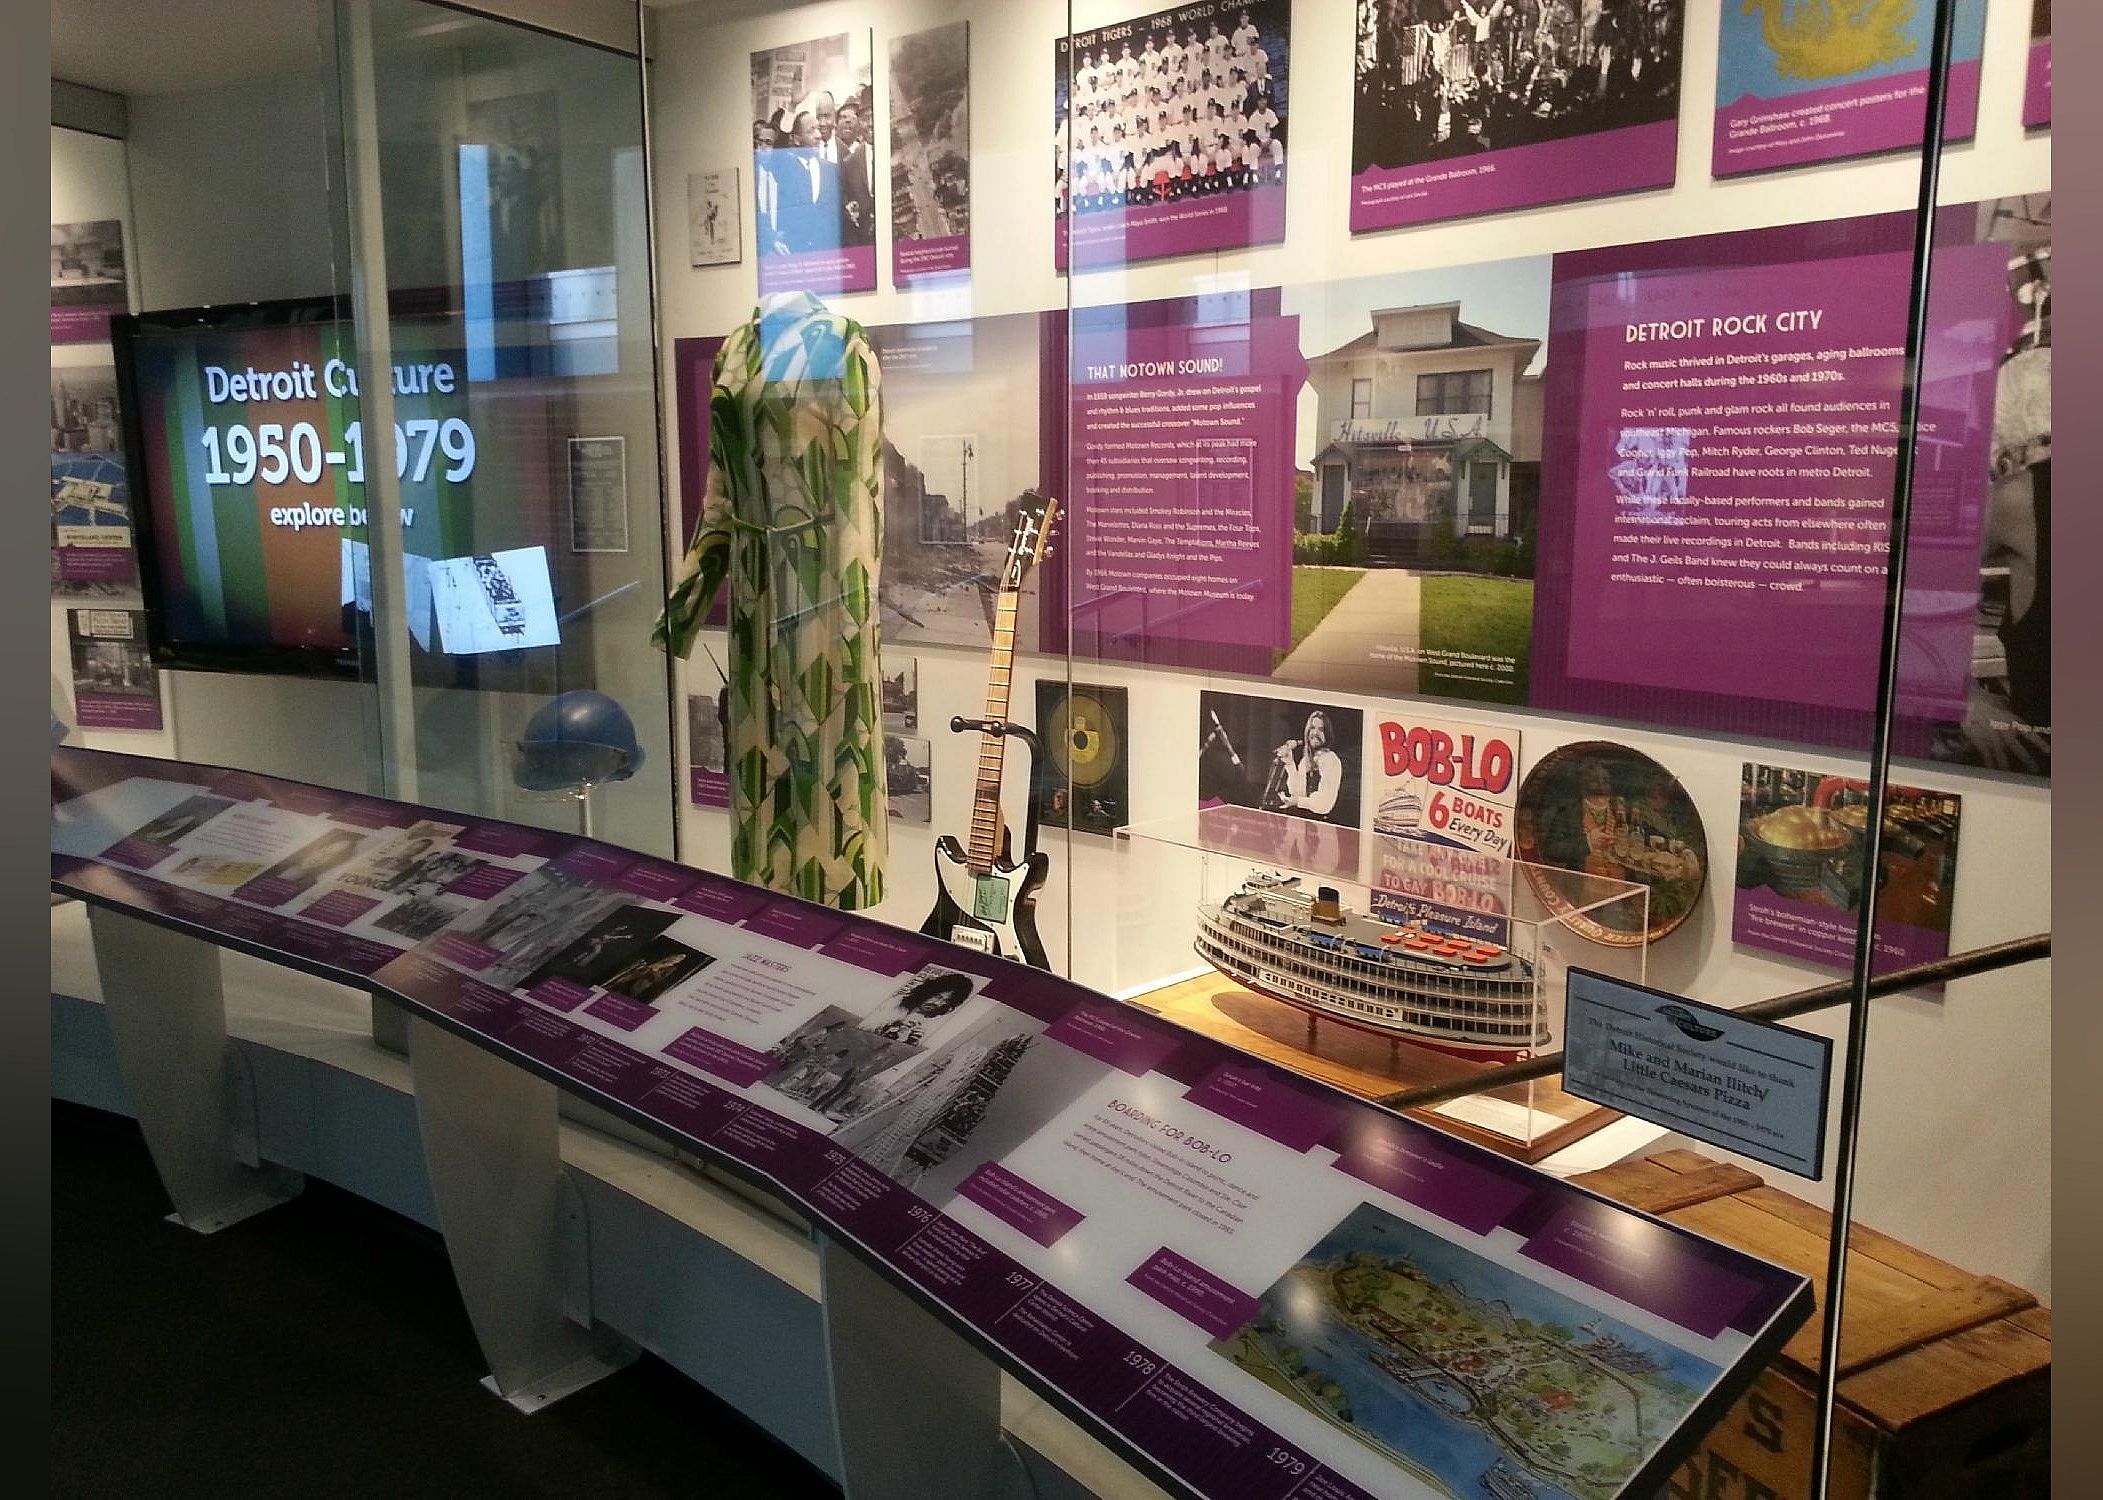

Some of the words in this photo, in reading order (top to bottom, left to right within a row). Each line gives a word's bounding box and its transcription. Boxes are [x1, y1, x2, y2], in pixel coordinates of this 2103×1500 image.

[1102, 25, 1132, 42] TIGERS
[1151, 15, 1172, 30] 1968
[1178, 4, 1215, 22] WORLD
[1824, 99, 1858, 112] concert
[1626, 319, 1705, 343] DETROIT
[1712, 314, 1767, 336] ROCK
[1775, 309, 1823, 332] CITY
[1087, 365, 1115, 380] THAT
[1178, 357, 1223, 375] SOUND!
[1624, 360, 1648, 371] Rock
[1649, 358, 1677, 369] music
[1679, 356, 1713, 367] thrived
[1715, 354, 1725, 365] in
[1726, 353, 1769, 365] Detroit's
[1816, 349, 1847, 361] aging
[1848, 346, 1906, 358] ballrooms
[206, 360, 317, 403] Detroit
[325, 359, 455, 398] Cuure
[1623, 381, 1640, 390] and
[1642, 378, 1678, 390] concert
[1680, 376, 1703, 387] halls
[1704, 376, 1736, 387] during
[1738, 375, 1755, 385] the
[1756, 372, 1788, 384] 1960s
[1789, 373, 1809, 383] and
[1812, 370, 1846, 382] 1970s.
[1621, 408, 1644, 418] Rock
[1677, 405, 1702, 418] punk
[1704, 405, 1723, 415] and
[1725, 404, 1749, 416] glam
[1751, 403, 1773, 413] rock
[1775, 402, 1788, 412] all
[1790, 401, 1821, 412] found
[1823, 400, 1877, 412] audiences
[1879, 400, 1890, 410] in
[1713, 425, 1751, 436] Famous
[1753, 424, 1791, 435] rockers
[1793, 423, 1814, 434] Bob
[1816, 423, 1848, 435] Seger,
[1850, 422, 1869, 433] the
[202, 416, 476, 485] 1950-179
[1702, 448, 1730, 457] Mitch
[1731, 446, 1762, 458] Ryder,
[1764, 445, 1802, 457] George
[1804, 445, 1846, 456] Clinton,
[1849, 444, 1868, 455] Ted
[1691, 467, 1730, 477] Railroad
[1733, 467, 1756, 477] have
[1758, 467, 1784, 477] roots
[1786, 467, 1797, 476] in
[1799, 467, 1830, 477] metro
[1832, 467, 1872, 477] Detroit.
[271, 501, 345, 530] explore
[350, 502, 413, 527] bew
[1734, 496, 1790, 508] performers
[1792, 497, 1812, 507] and
[1814, 497, 1846, 508] bands
[1848, 498, 1885, 510] gained
[1714, 517, 1750, 528] touring
[1751, 518, 1773, 528] acts
[1774, 518, 1799, 528] from
[1801, 518, 1855, 529] elsewhere
[1857, 519, 1887, 530] often
[1613, 535, 1639, 544] made
[1640, 535, 1662, 545] their
[1663, 535, 1680, 545] live
[1681, 535, 1732, 548] recordings
[1734, 537, 1744, 547] in
[1745, 537, 1782, 548] Detroit.
[1788, 539, 1820, 551] Bands
[1821, 541, 1871, 554] including
[1612, 554, 1629, 563] and
[1631, 554, 1648, 564] The
[1659, 555, 1683, 565] Geils
[1685, 555, 1709, 566] Band
[1711, 557, 1737, 568] knew
[1739, 558, 1761, 571] they
[1763, 559, 1792, 570] could
[1793, 560, 1828, 573] always
[1830, 563, 1862, 575] count
[1864, 565, 1879, 575] on
[1880, 566, 1889, 576] a
[1611, 573, 1664, 584] enthusiastic
[1677, 576, 1703, 587] often
[1704, 577, 1756, 589] boisterous
[1769, 580, 1804, 592] crowd.
[1379, 722, 1513, 795] BOB-LO
[1428, 790, 1450, 830] 6
[1451, 796, 1504, 829] BOATS
[1449, 817, 1483, 842] Every
[1483, 828, 1509, 852] Day
[1418, 903, 1463, 927] Pleasure
[1462, 915, 1500, 935] Island
[1609, 1038, 1644, 1060] Mike
[1647, 1053, 1671, 1070] and
[1674, 1059, 1722, 1086] Marian
[1623, 1058, 1659, 1080] Little
[1660, 1070, 1711, 1098] Caesars
[1714, 1086, 1752, 1111] Pizza
[1107, 1099, 1161, 1130] BOARDING
[1159, 1124, 1184, 1140] FOR
[1182, 1136, 1232, 1163] BOB-LO
[907, 1204, 932, 1224] 1976
[1005, 1271, 1035, 1291] 1977
[1122, 1350, 1156, 1376] 1978
[1266, 1446, 1306, 1477] 1979
